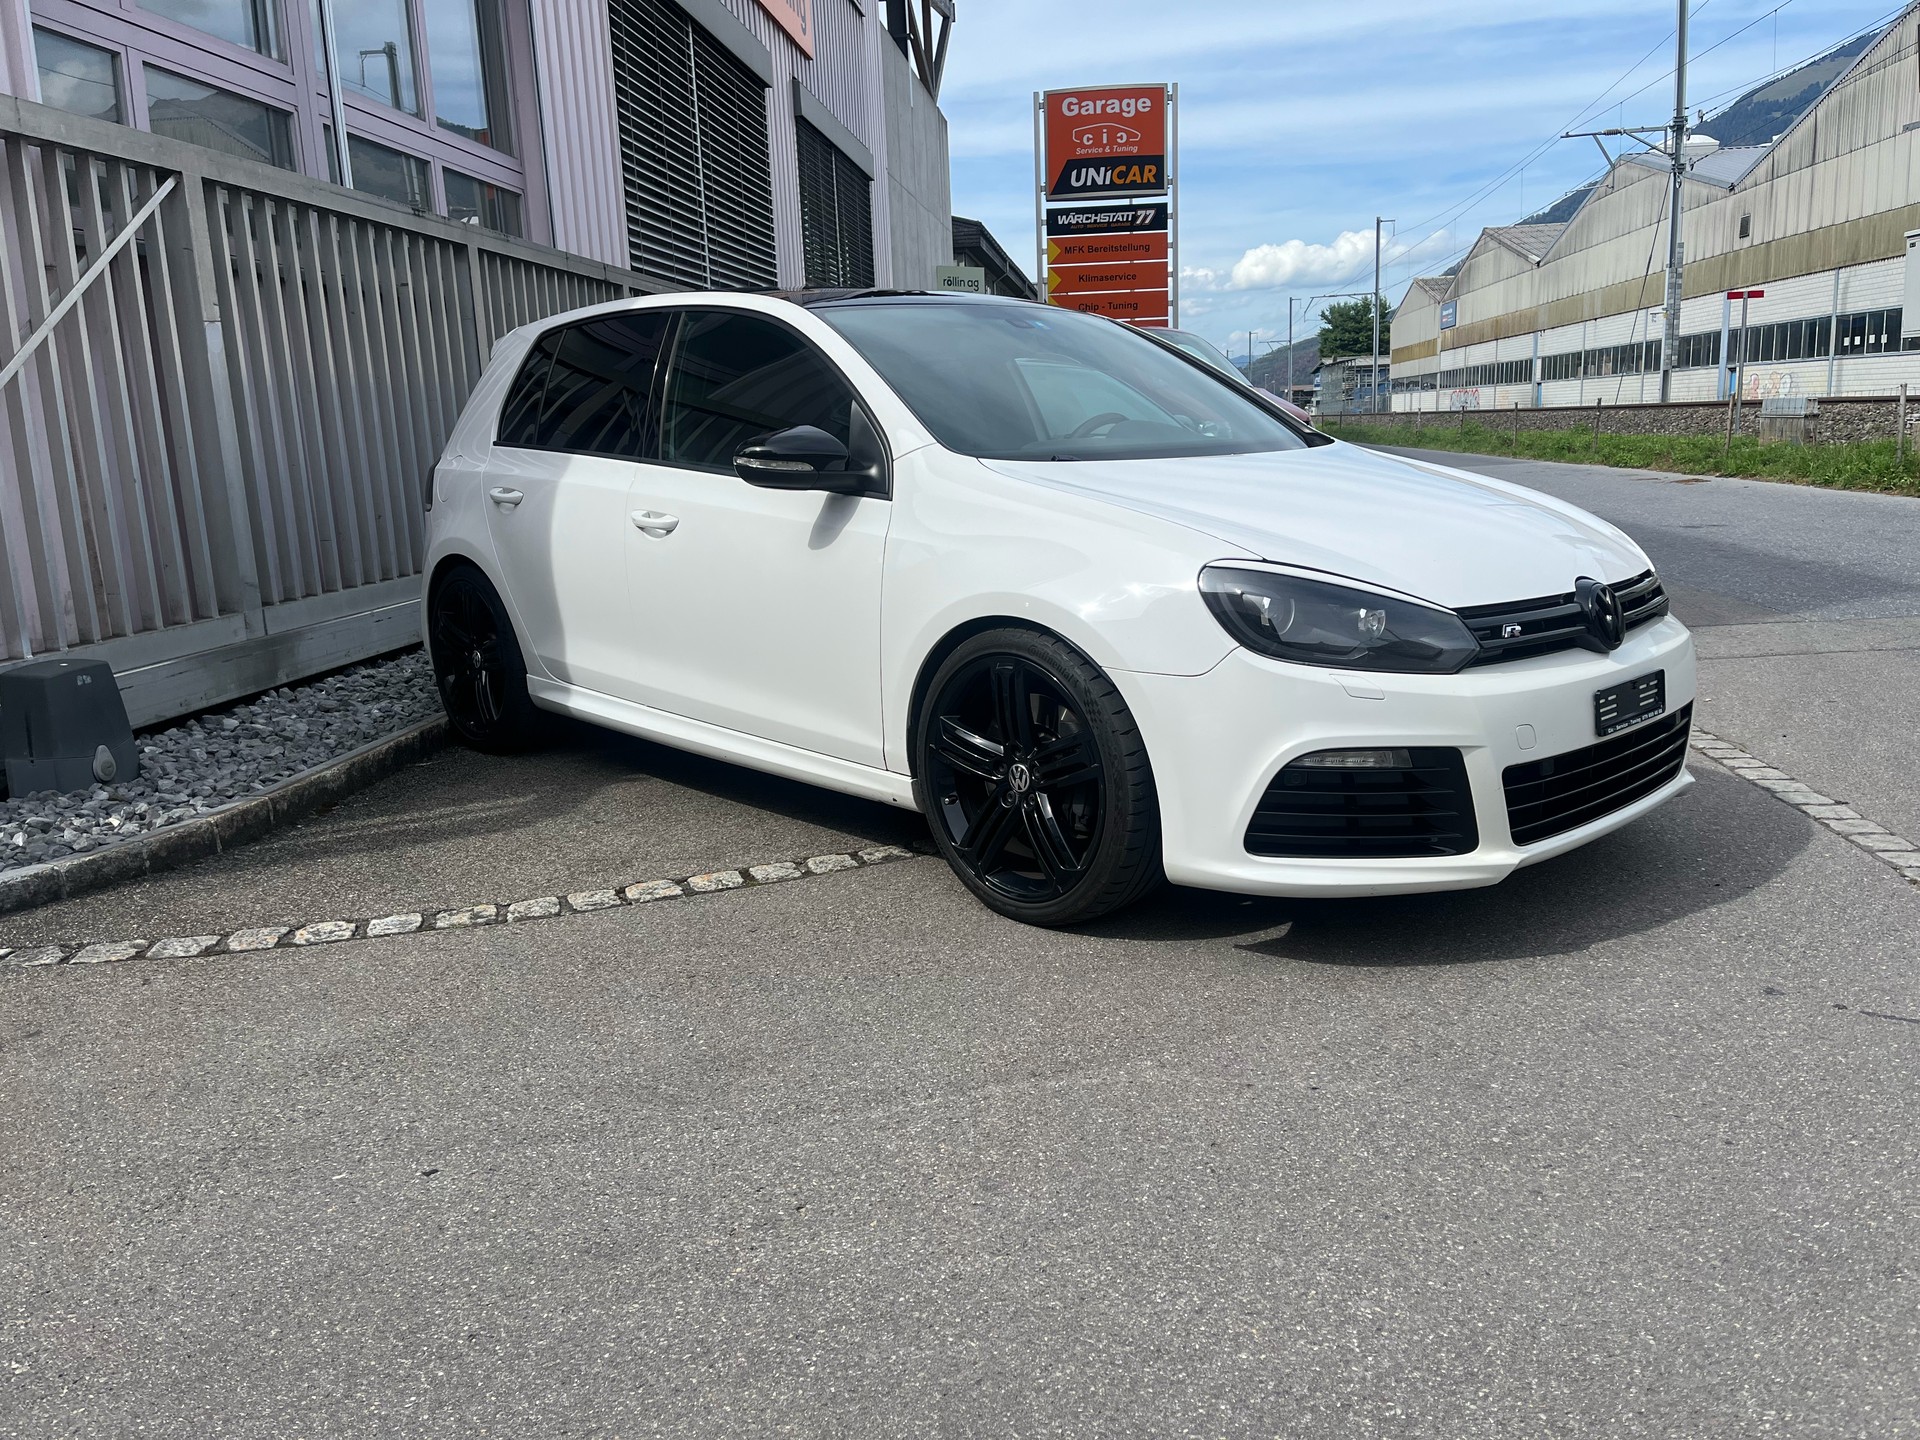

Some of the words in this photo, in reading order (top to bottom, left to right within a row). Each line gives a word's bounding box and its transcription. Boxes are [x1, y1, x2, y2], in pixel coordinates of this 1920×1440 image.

[1061, 96, 1152, 118] Garage
[1076, 147, 1103, 155] Service
[1104, 145, 1111, 153] &
[1113, 145, 1138, 154] Tuning
[1057, 211, 1136, 225] WÄRCHSTATT
[1135, 208, 1157, 226] 77
[1064, 245, 1085, 256] MFK
[1087, 243, 1151, 254] Bereitstellung
[1078, 272, 1137, 283] Klimaservice
[967, 279, 980, 292] ag
[1078, 302, 1100, 313] Chip
[1107, 301, 1139, 311] Tuning
[1502, 622, 1522, 639] R
[1028, 644, 1075, 683] Continental
[1008, 763, 1030, 793] VW
